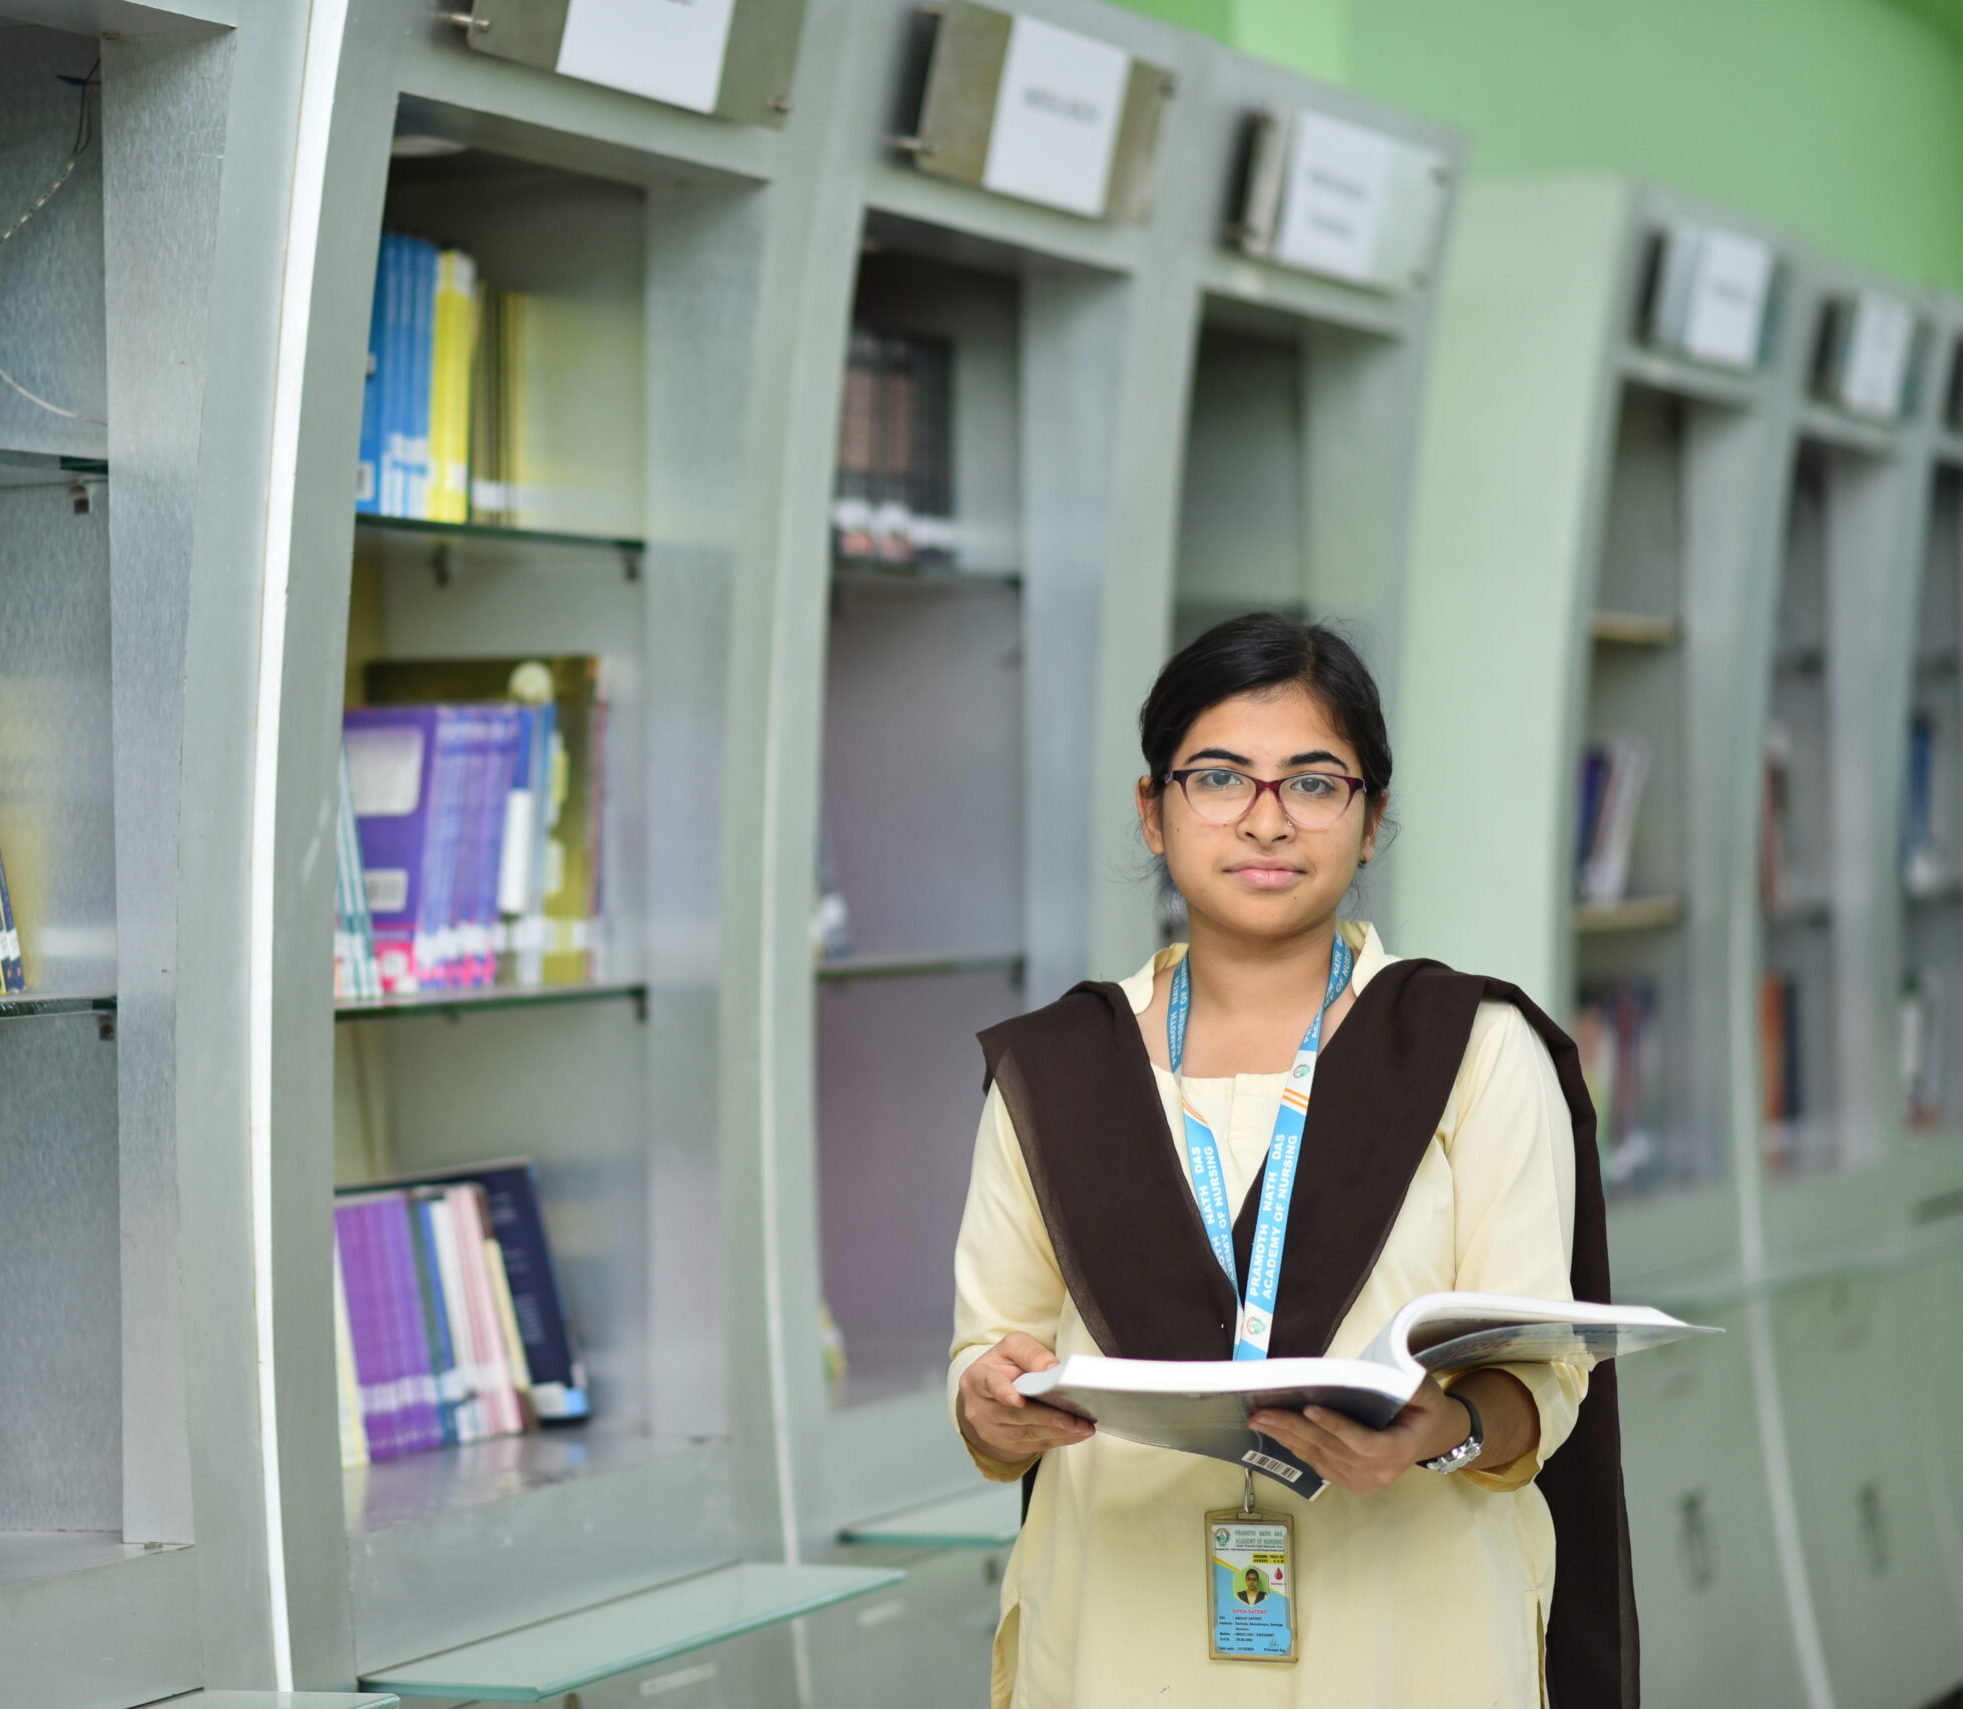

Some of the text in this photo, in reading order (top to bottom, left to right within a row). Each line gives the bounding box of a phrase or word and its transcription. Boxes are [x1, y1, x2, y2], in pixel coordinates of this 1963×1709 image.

[1333, 951, 1343, 977] NATH
[1191, 1146, 1216, 1225] NATH DAS
[1204, 1145, 1224, 1207] NURSING
[1217, 1210, 1227, 1229] OF
[1250, 1133, 1286, 1297] PRAMOTH NATH DAS
[1262, 1135, 1298, 1299] ACADEMY OF NURSING
